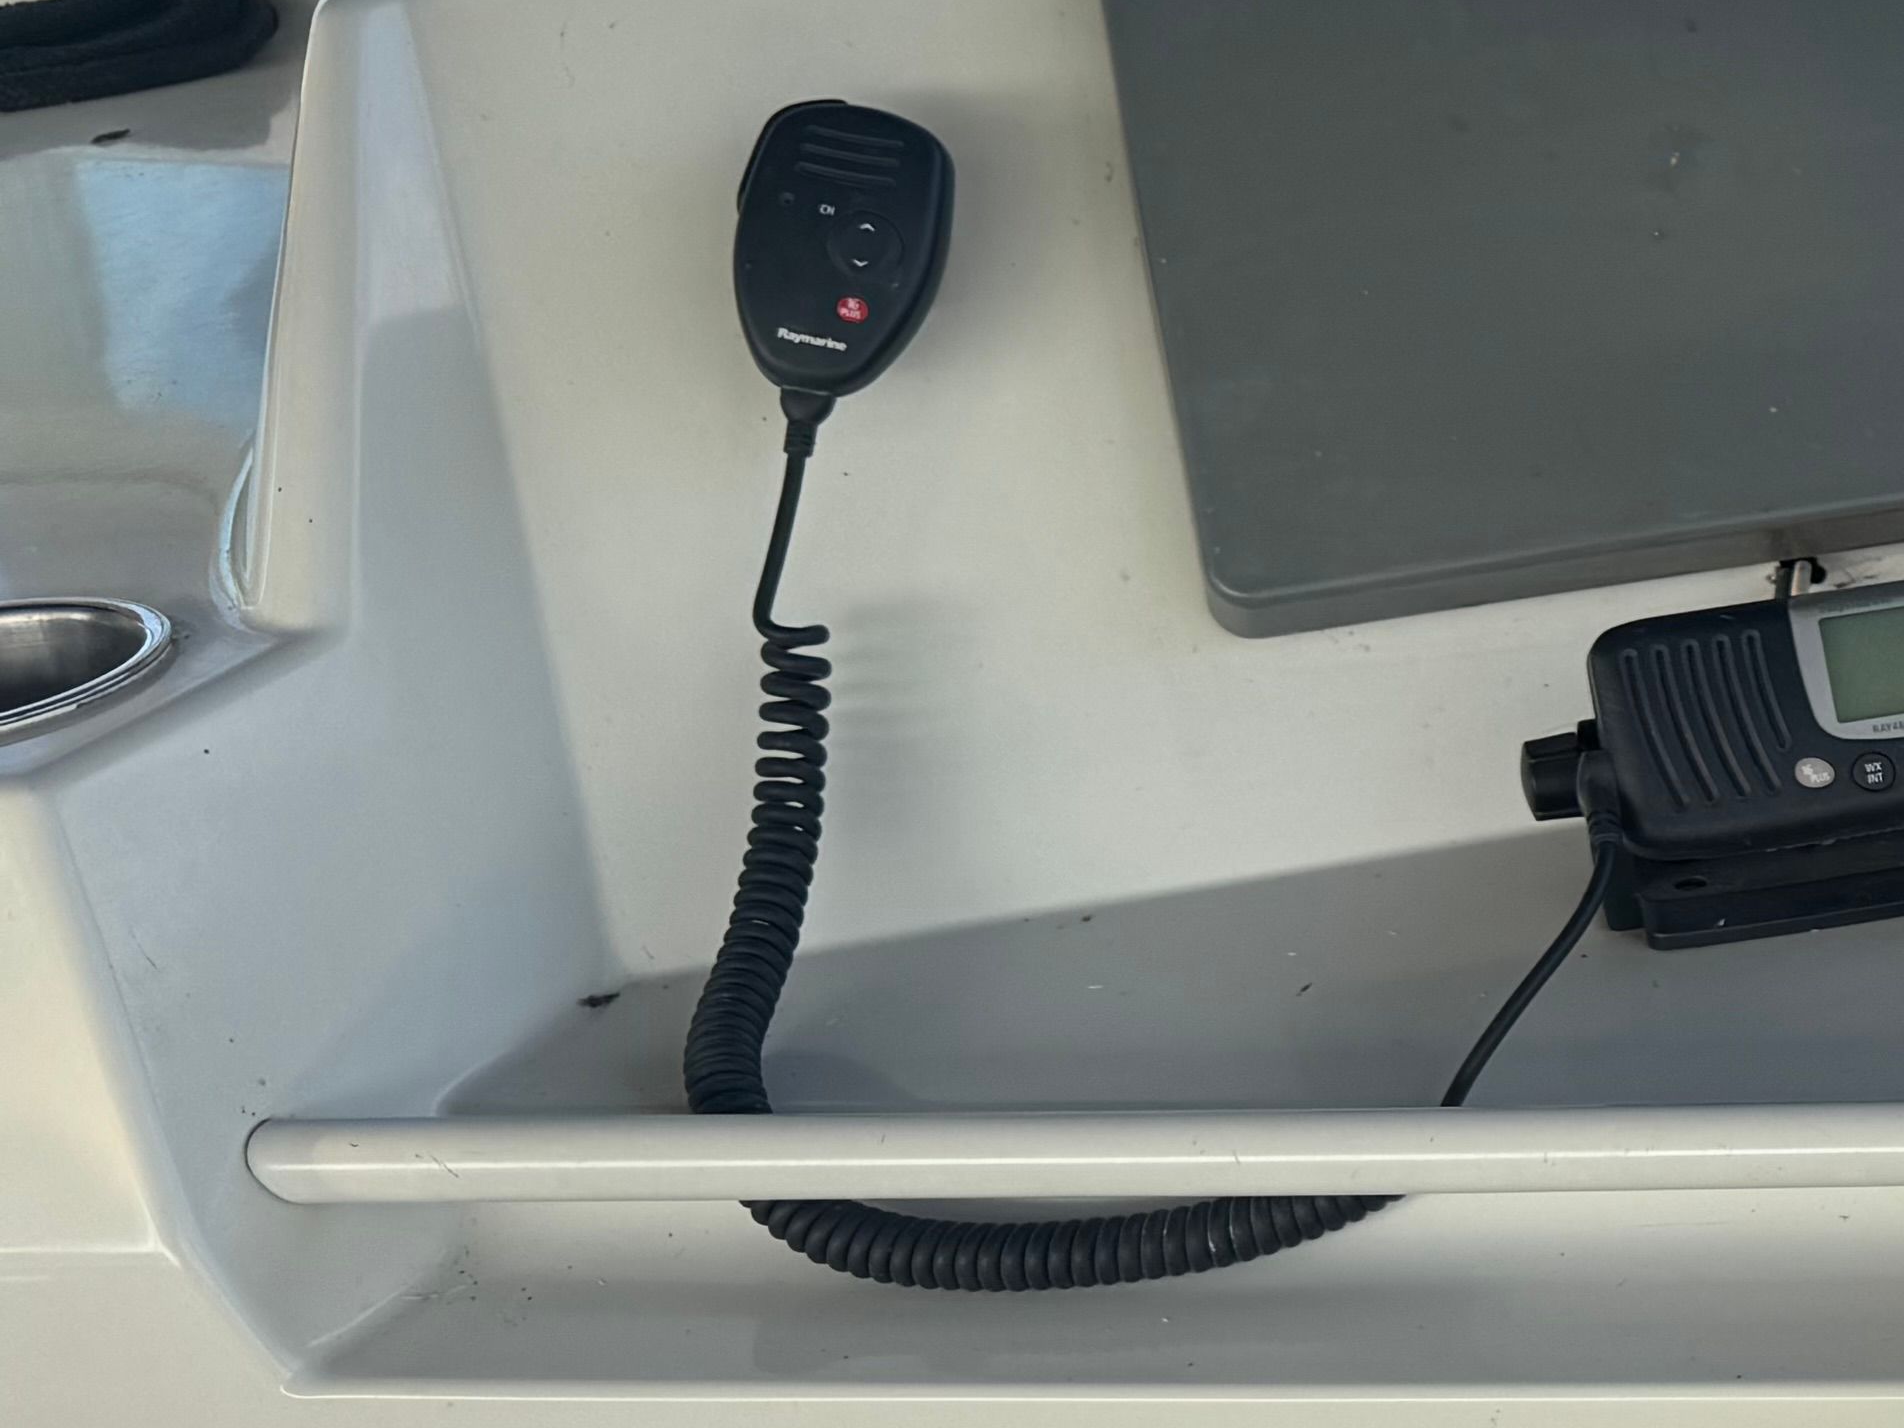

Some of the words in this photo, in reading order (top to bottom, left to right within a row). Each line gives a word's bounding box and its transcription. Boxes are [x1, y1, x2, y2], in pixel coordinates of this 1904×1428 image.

[818, 203, 836, 216] CH
[777, 327, 848, 352] Raymarine
[1864, 761, 1883, 773] WX
